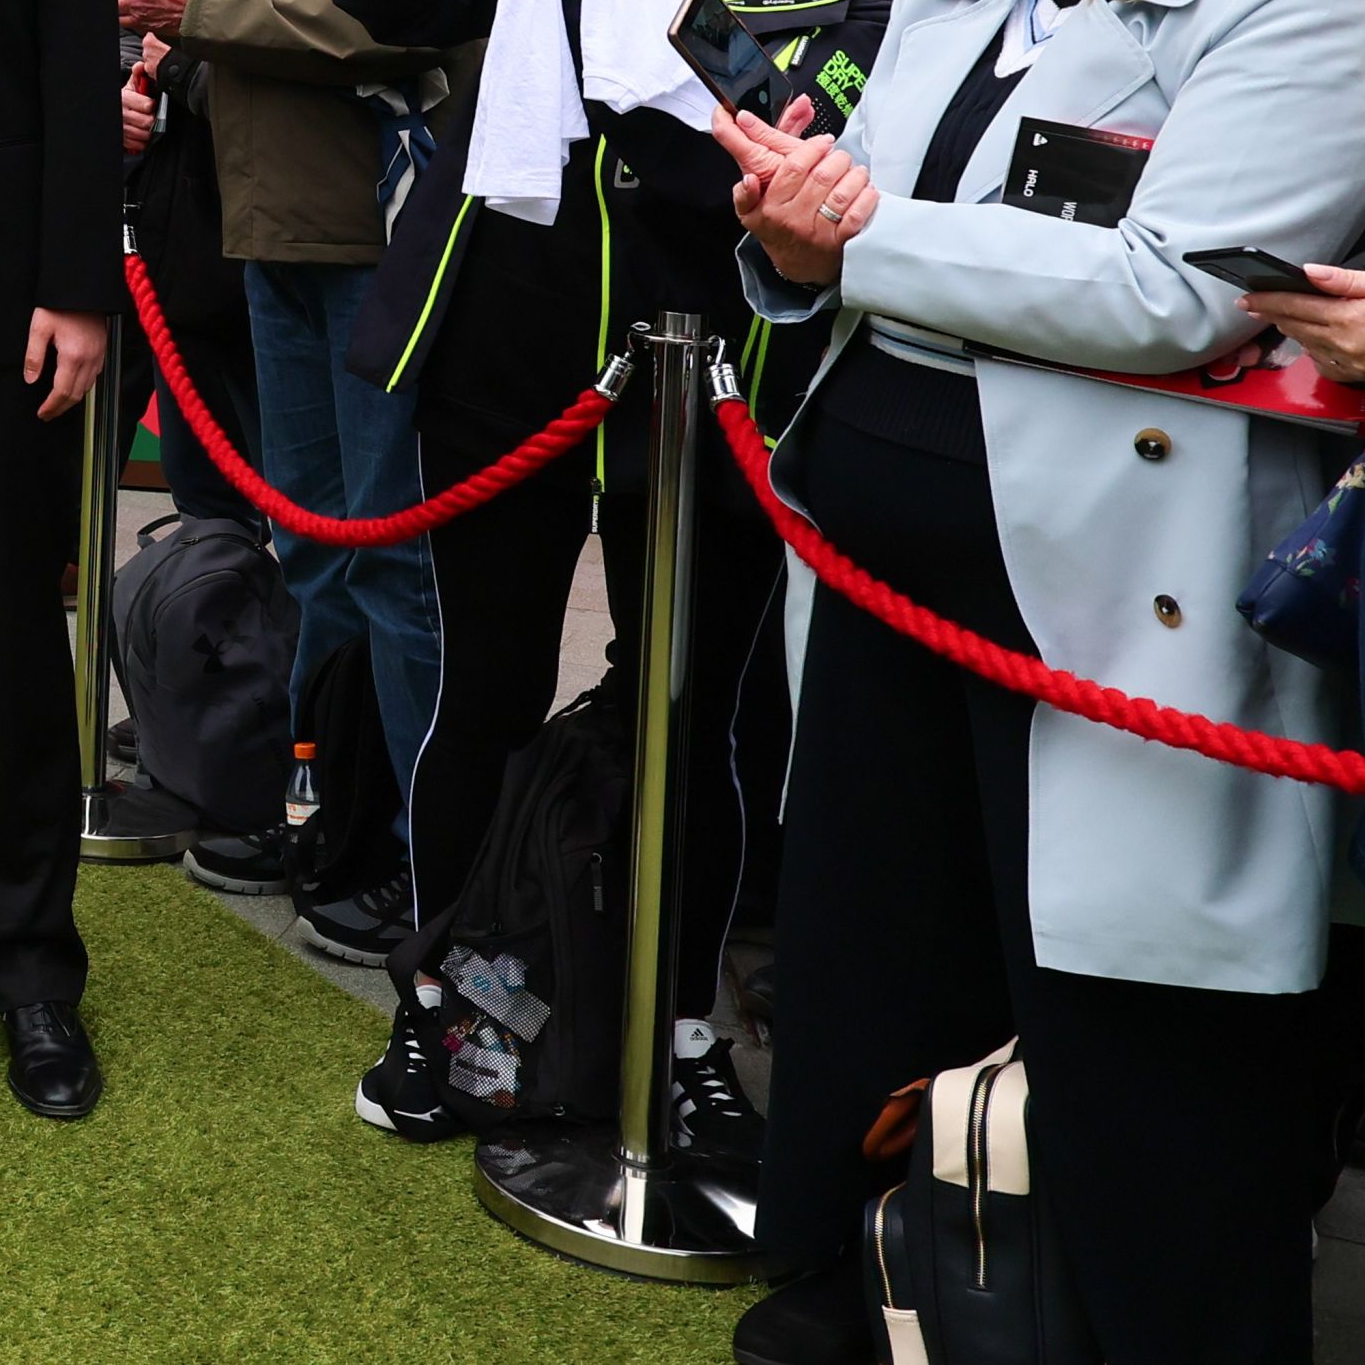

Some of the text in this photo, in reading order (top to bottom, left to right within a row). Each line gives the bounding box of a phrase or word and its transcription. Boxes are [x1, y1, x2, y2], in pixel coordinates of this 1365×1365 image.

[823, 59, 854, 91] DRY
[832, 50, 867, 93] SUPE
[1023, 169, 1038, 197] HALO
